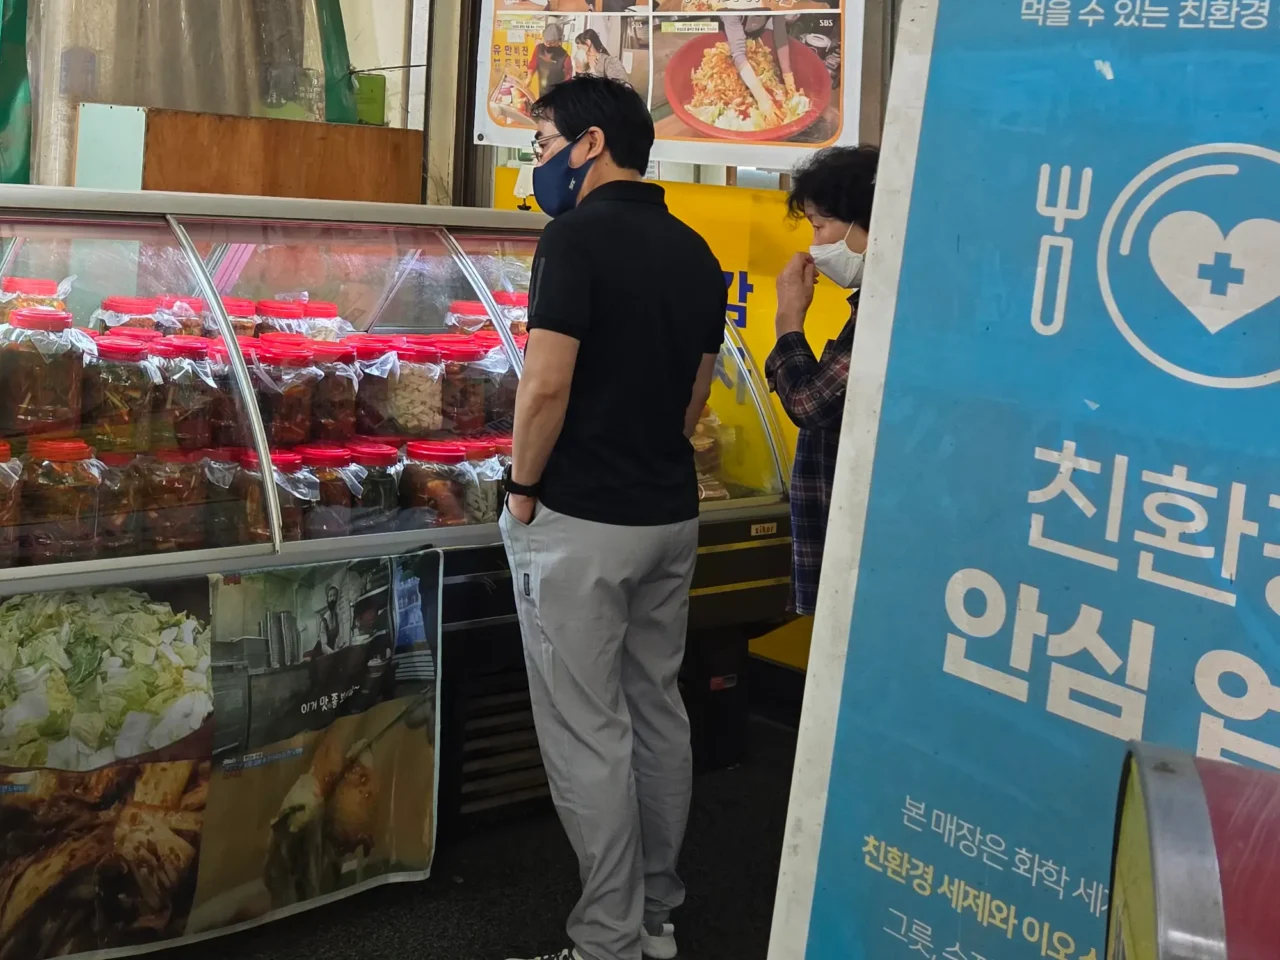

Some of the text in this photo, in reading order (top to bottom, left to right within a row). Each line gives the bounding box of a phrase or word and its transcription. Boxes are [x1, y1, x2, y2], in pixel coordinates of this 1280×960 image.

[819, 19, 834, 27] SBS
[943, 567, 1156, 742] 안심
[861, 834, 1097, 960] 친환경 세제와 이오
[901, 795, 1110, 918] 본 매장은 화학 세
